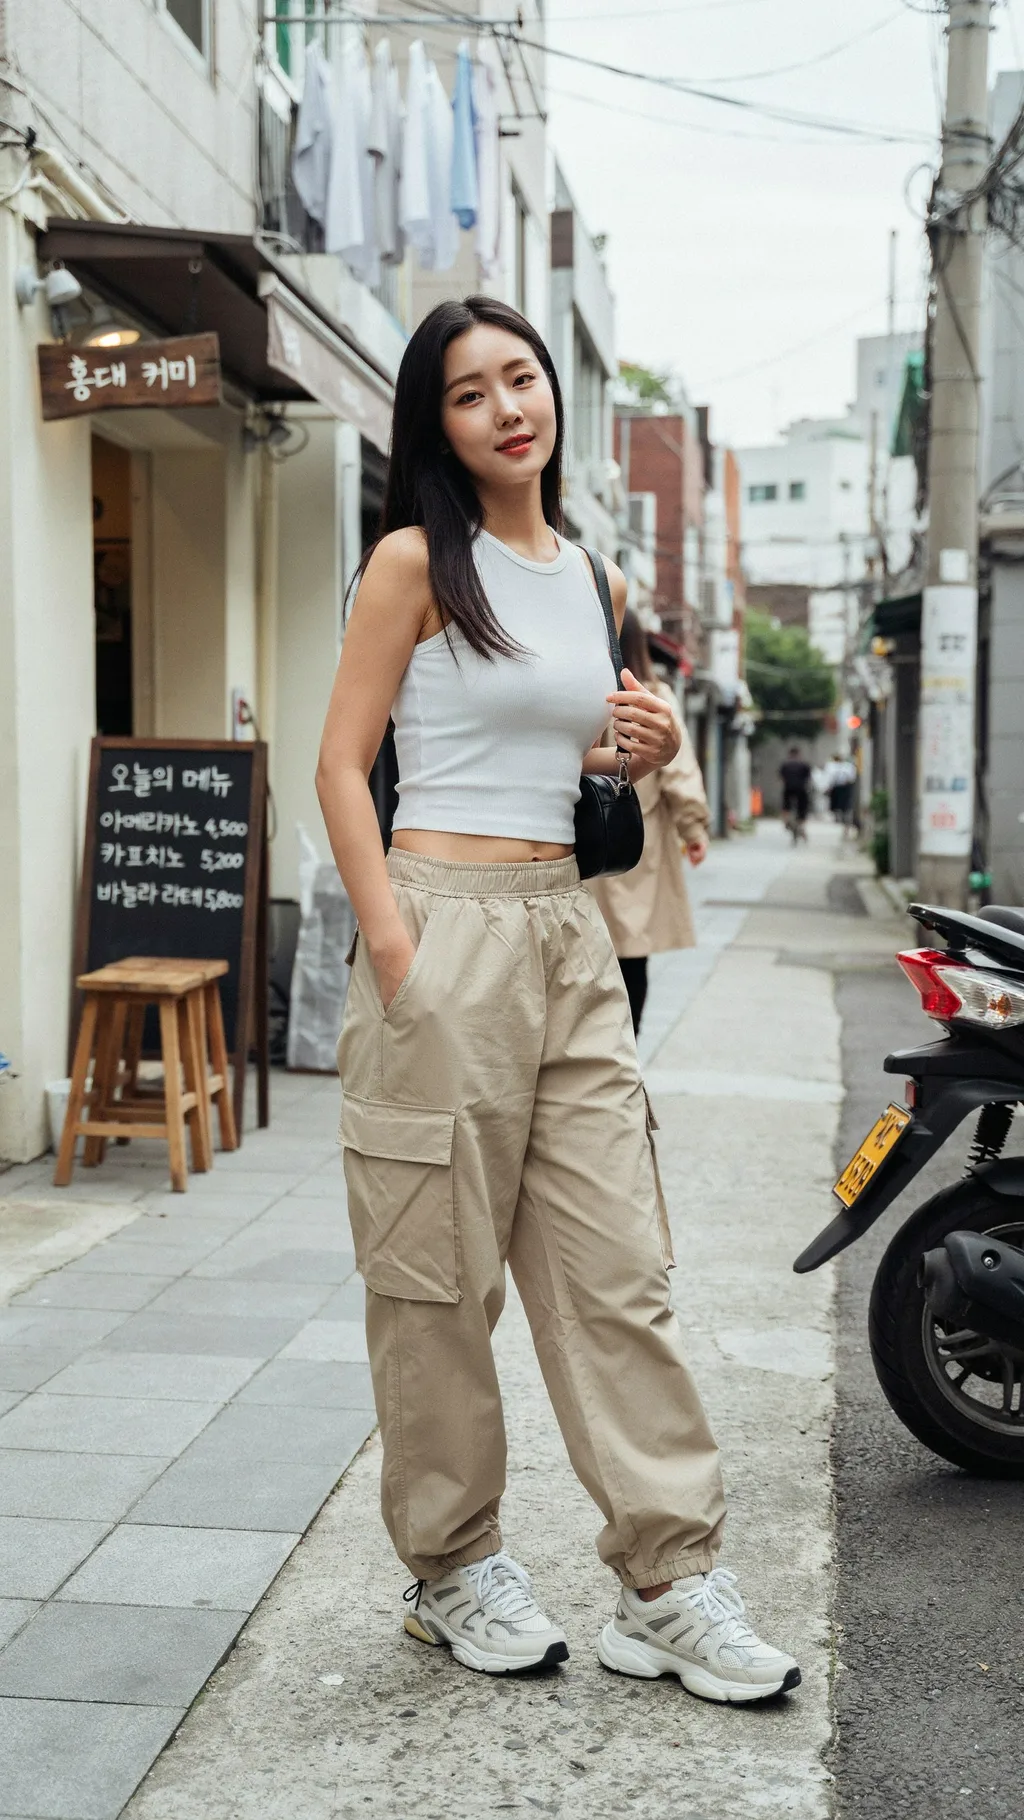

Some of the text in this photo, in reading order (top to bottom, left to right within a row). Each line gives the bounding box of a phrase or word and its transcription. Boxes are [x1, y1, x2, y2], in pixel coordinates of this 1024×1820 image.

[64, 354, 197, 401] 홍대 커미
[107, 762, 234, 798] 오늘의 메뉴
[204, 817, 249, 840] 4,500
[100, 842, 245, 874] 카프치노 5,200
[161, 883, 203, 908] 라테
[203, 887, 244, 913] 5,800
